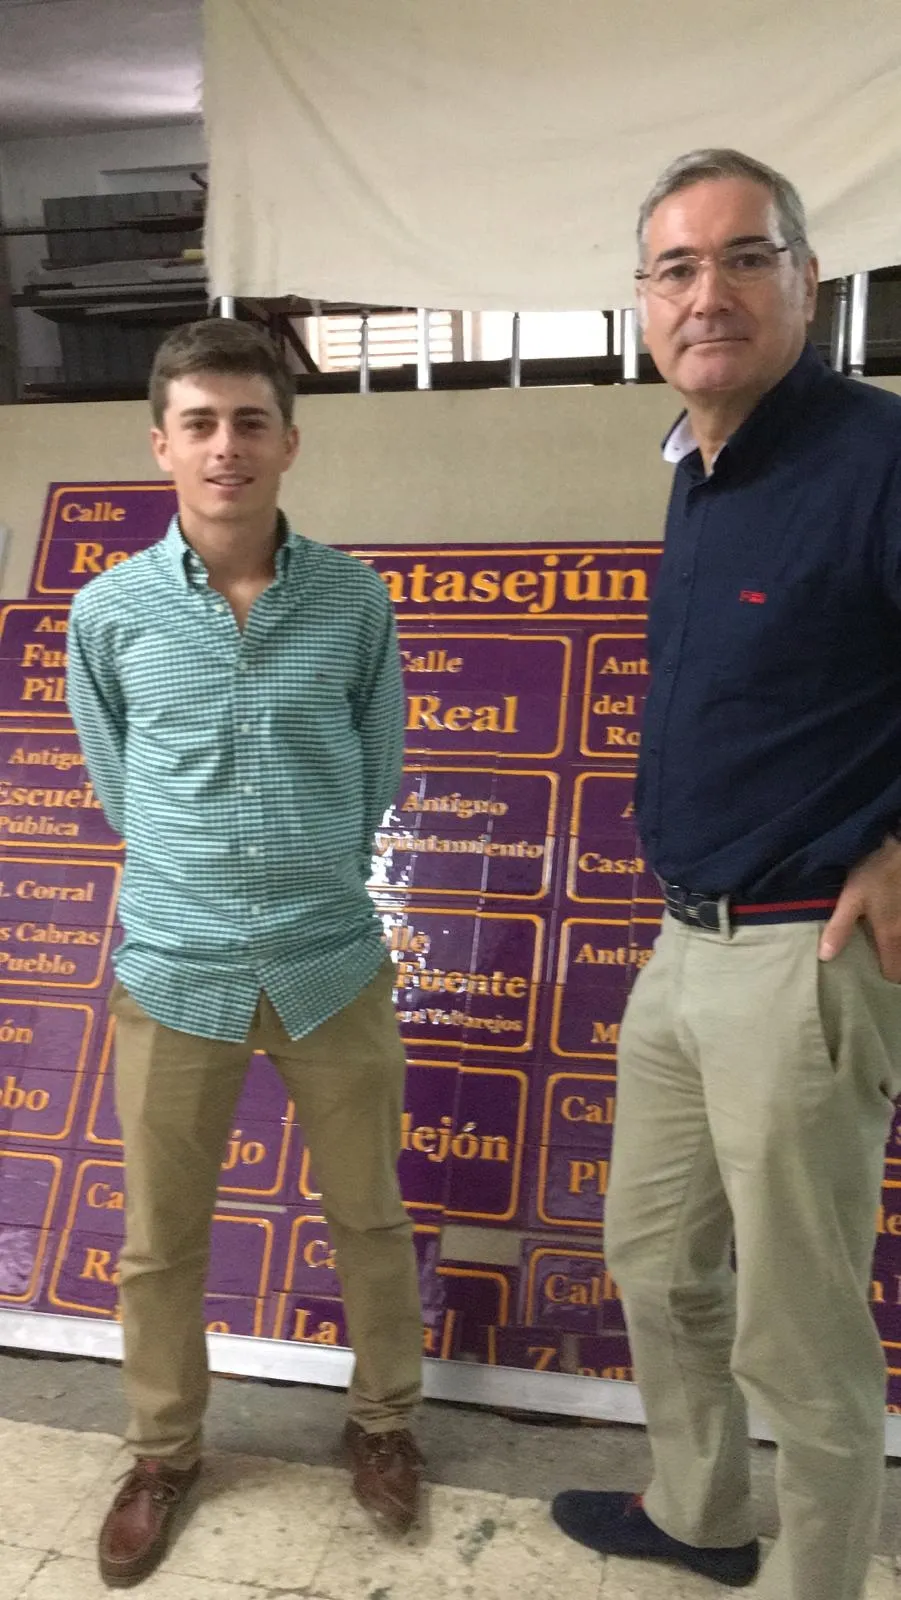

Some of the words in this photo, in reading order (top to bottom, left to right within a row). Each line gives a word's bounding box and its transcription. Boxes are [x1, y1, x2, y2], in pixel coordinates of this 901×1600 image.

[60, 502, 127, 523] Calle
[362, 555, 650, 613] atasejún
[403, 694, 520, 733] Real
[592, 694, 636, 715] del
[605, 726, 641, 746] Ro
[401, 791, 509, 819] Antiguo
[578, 852, 647, 874] Casa
[15, 880, 95, 902] Corral
[15, 922, 103, 946] Cabras
[382, 926, 432, 953] lle
[395, 961, 528, 999] Fuente
[0, 1075, 51, 1112] bo
[291, 1308, 339, 1345] La
